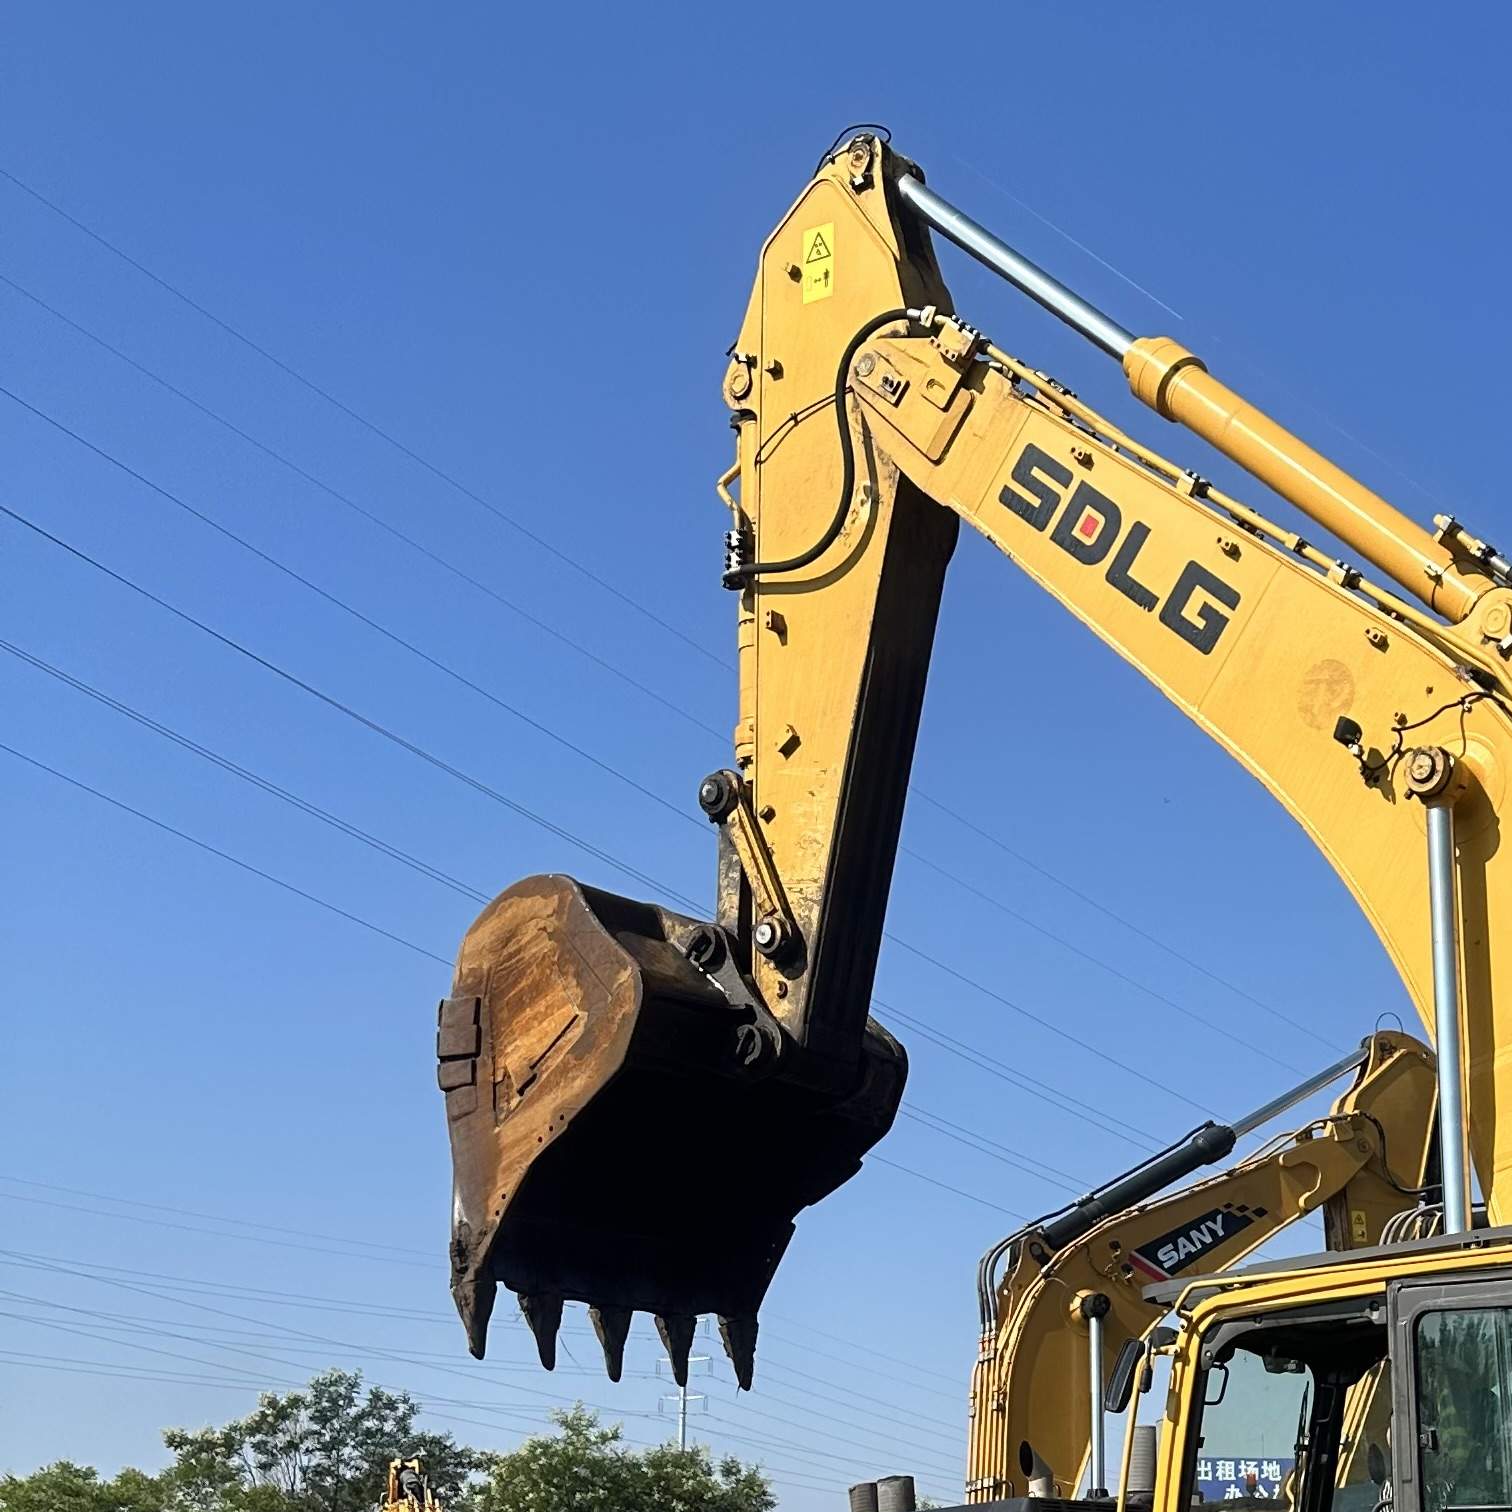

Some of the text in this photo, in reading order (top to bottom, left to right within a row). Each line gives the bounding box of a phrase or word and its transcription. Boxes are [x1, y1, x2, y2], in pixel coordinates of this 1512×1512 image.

[999, 443, 1242, 655] SDLG
[1157, 1213, 1225, 1269] SANY
[1197, 1460, 1282, 1481] 出租场地
